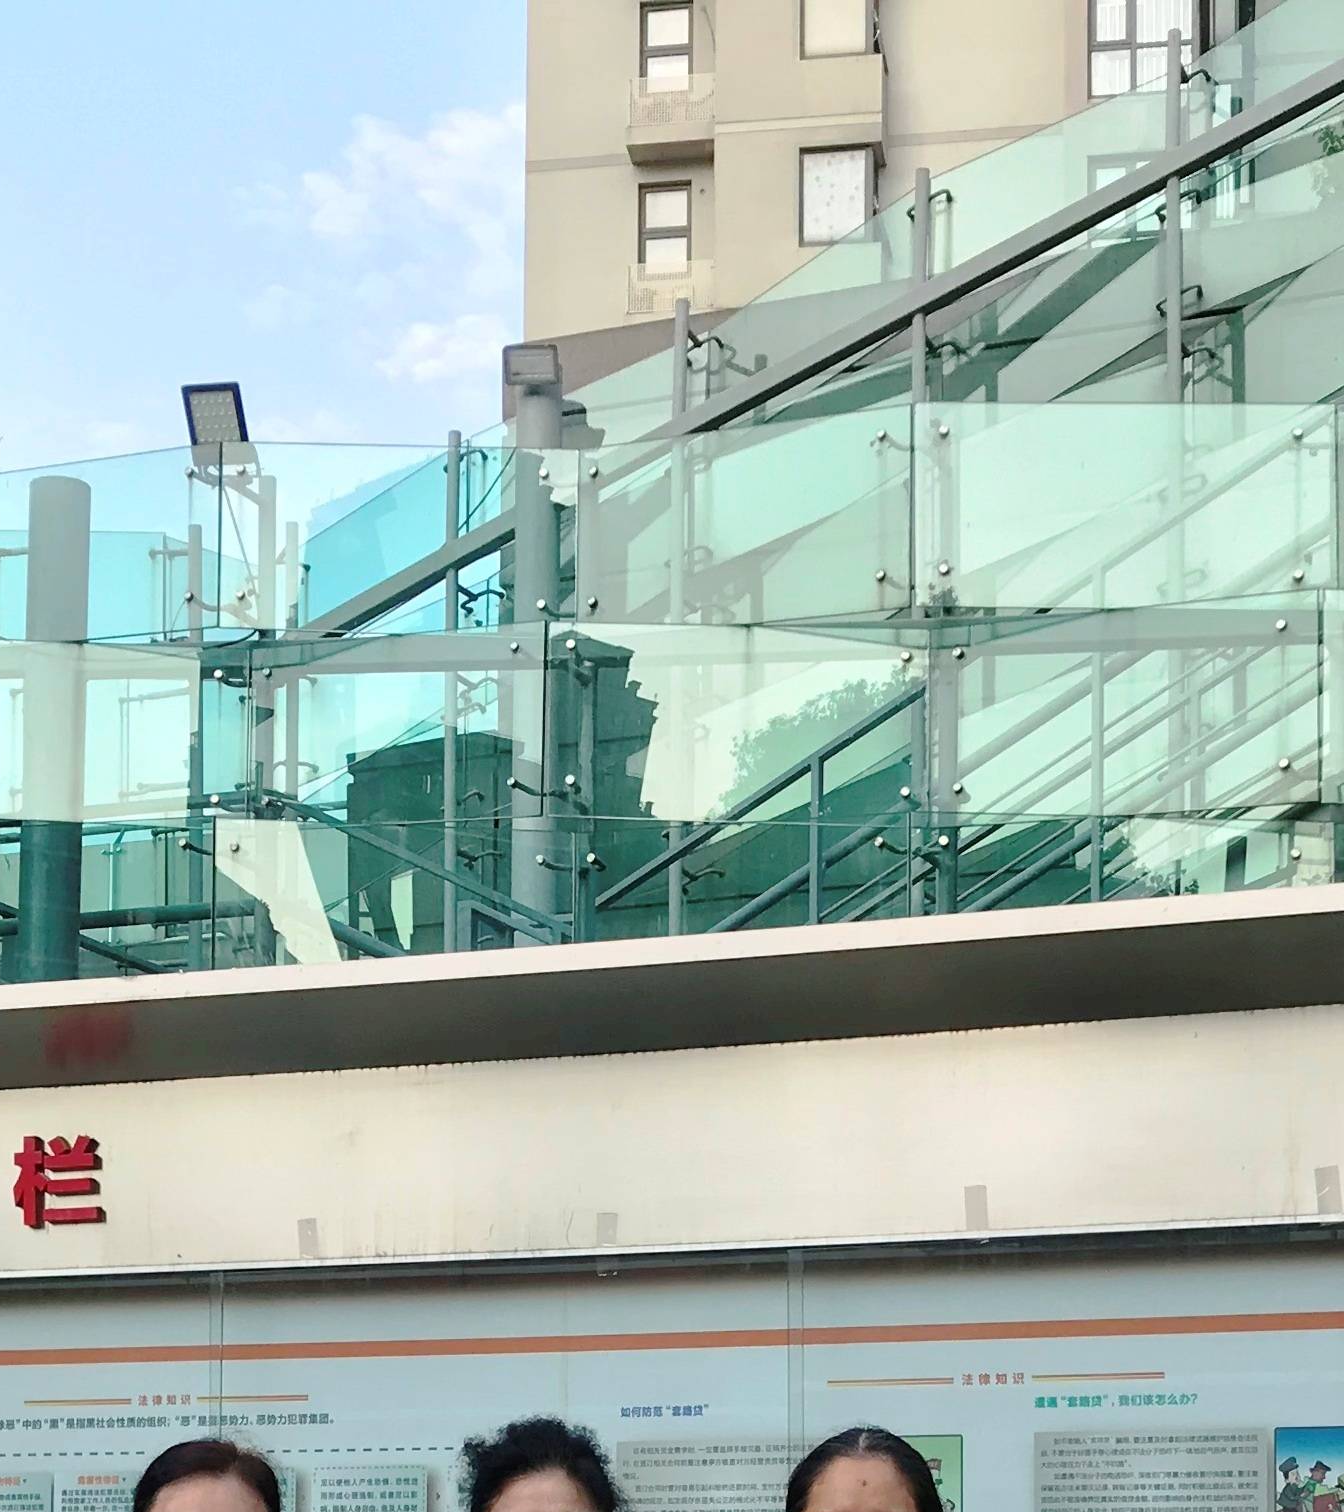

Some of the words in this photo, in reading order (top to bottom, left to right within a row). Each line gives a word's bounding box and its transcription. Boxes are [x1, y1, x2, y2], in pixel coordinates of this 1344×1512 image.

[962, 1372, 1025, 1386] 法律知识
[138, 1394, 191, 1406] 法律知识
